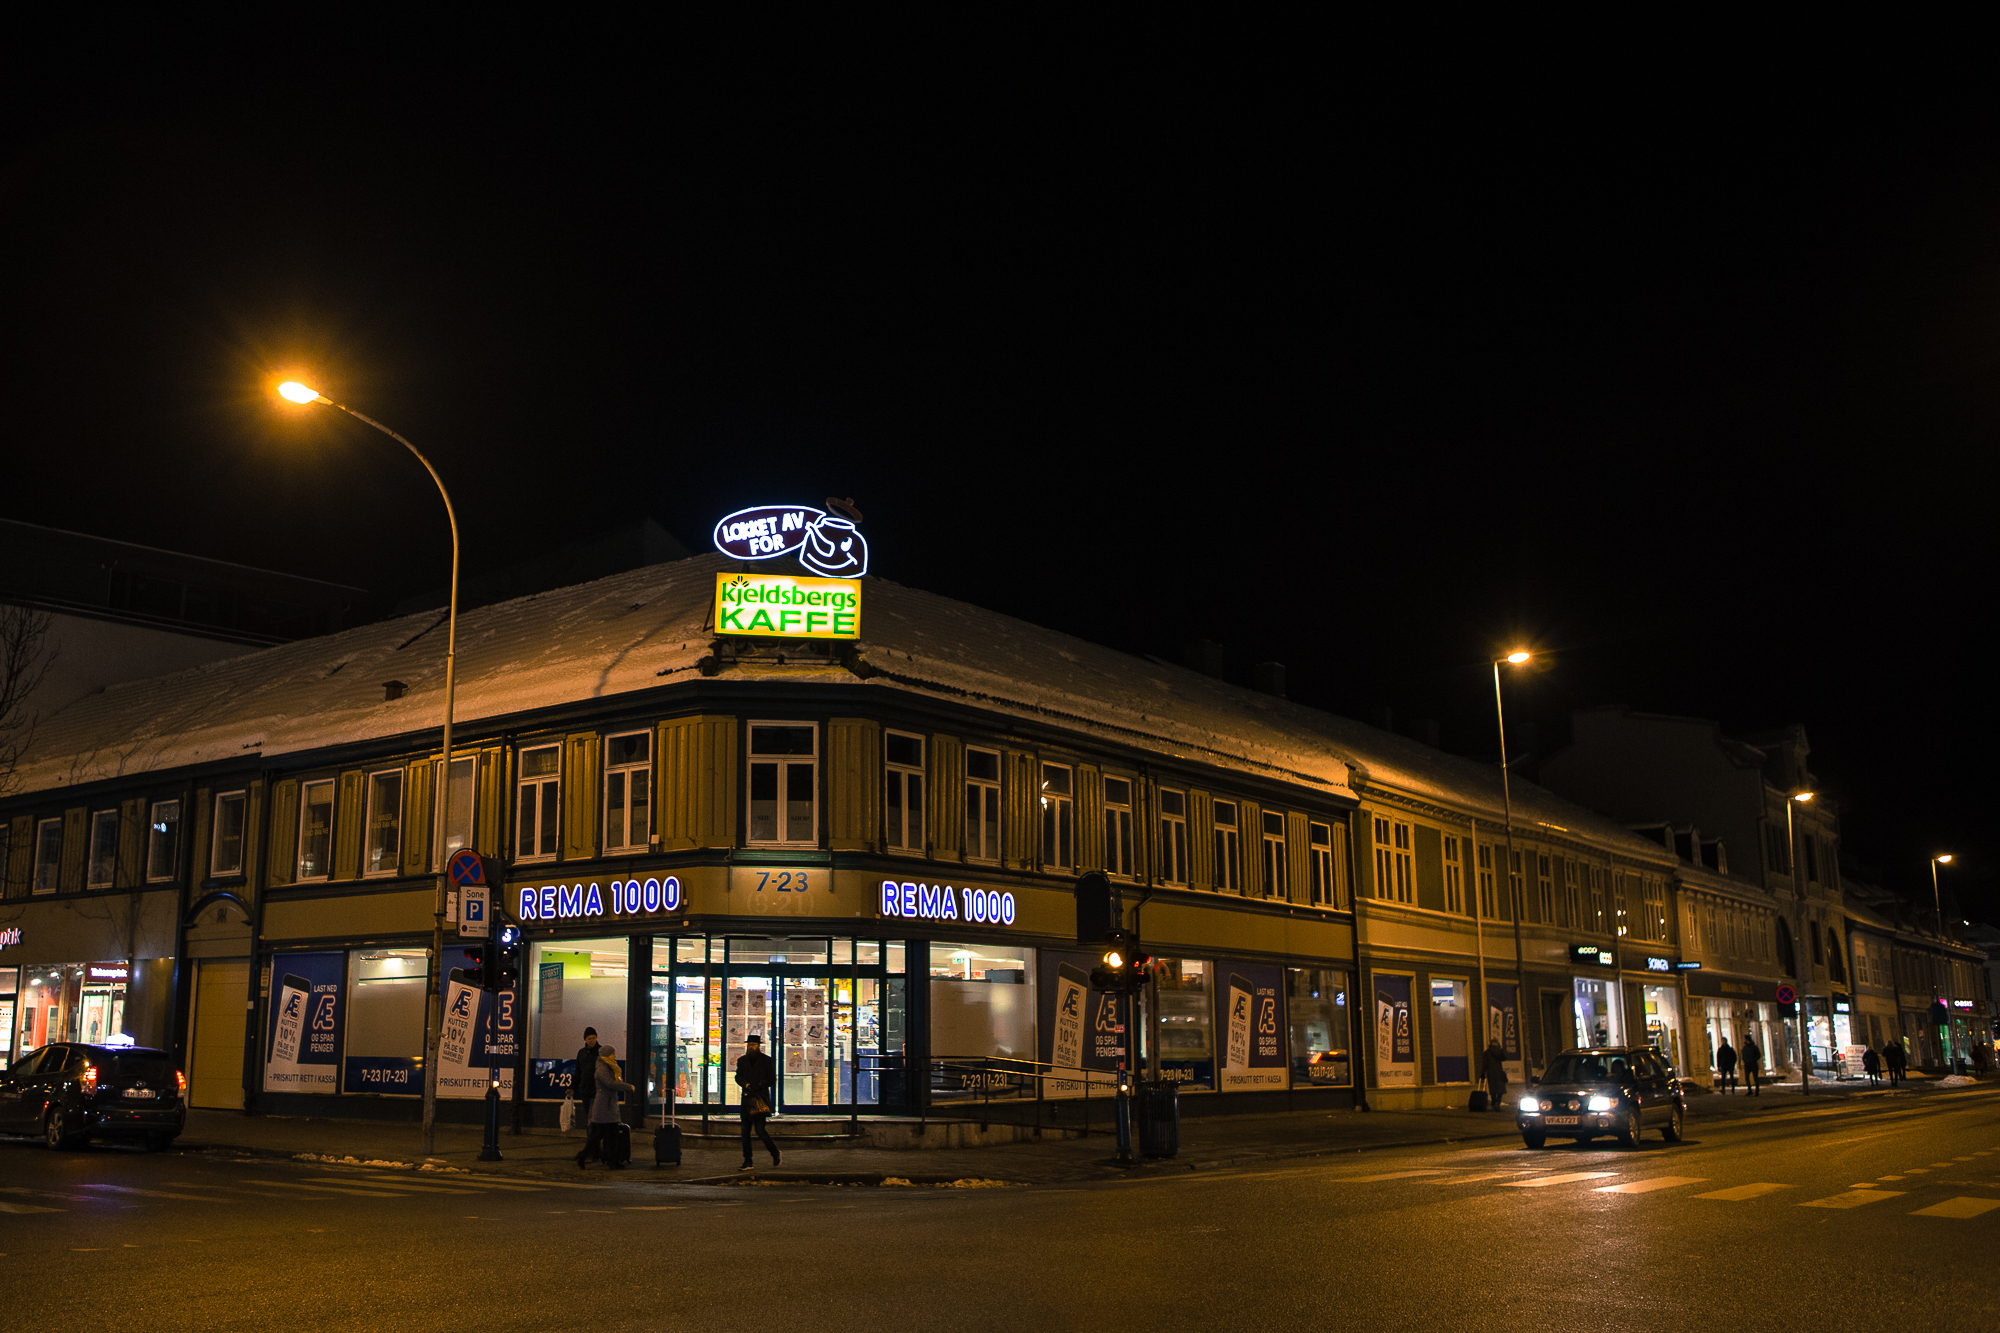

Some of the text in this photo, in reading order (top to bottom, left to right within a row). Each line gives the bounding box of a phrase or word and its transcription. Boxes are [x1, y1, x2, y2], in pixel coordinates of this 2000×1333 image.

[722, 511, 805, 543] LOKKET AV
[749, 534, 785, 555] FOR
[721, 581, 857, 612] kjeldsbergs
[720, 607, 856, 635] KAFFE
[756, 871, 809, 893] 7-23
[466, 889, 484, 899] Sone
[519, 875, 680, 921] REMA 1000
[882, 880, 1015, 925] REMA 1000
[313, 984, 337, 993] LAST NED
[1256, 987, 1266, 995] LAST
[283, 991, 302, 1020] Æ
[450, 987, 473, 1020] Æ
[1061, 984, 1080, 1020] Æ
[312, 994, 336, 1031] Æ
[1258, 997, 1276, 1035] Æ
[447, 1017, 469, 1029] KUTTER
[1059, 1018, 1079, 1030] KUTTER
[280, 1028, 296, 1043] 10%
[310, 1033, 335, 1042] OG SPAR
[447, 1027, 466, 1045] 10%
[1059, 1028, 1077, 1047] 10%
[1095, 1035, 1103, 1045] OG
[310, 1043, 335, 1053] PENGER
[1258, 1046, 1277, 1056] PENGER
[273, 1073, 299, 1082] PRISKUTT
[300, 1074, 314, 1082] RETT
[318, 1075, 336, 1083] KASSA
[361, 1068, 409, 1084] 7-23 (7-23)
[548, 1073, 572, 1087] 7-23
[961, 1075, 981, 1088] 7-23
[1174, 1068, 1194, 1081] (7-23)
[1230, 1075, 1252, 1084] PRISKUTT
[439, 1078, 471, 1087] PRISKUTT
[472, 1079, 490, 1088] RETT
